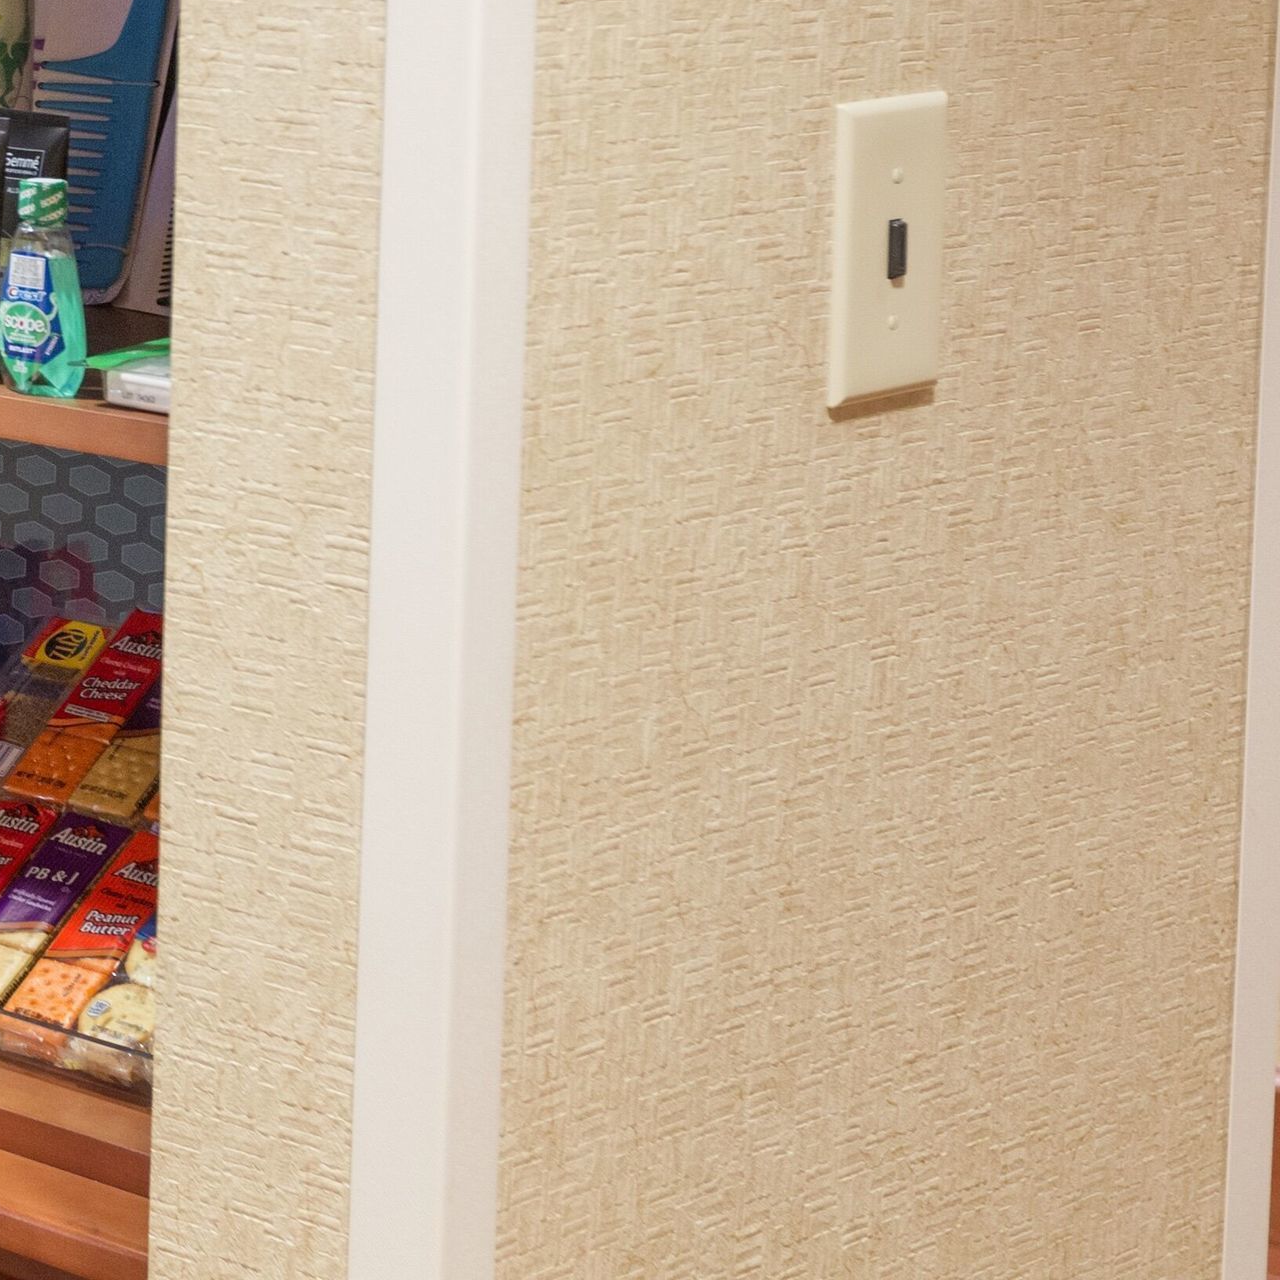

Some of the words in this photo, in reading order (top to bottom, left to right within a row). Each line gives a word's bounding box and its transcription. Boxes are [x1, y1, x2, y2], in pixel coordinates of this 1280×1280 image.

[5, 151, 40, 170] Semmé
[3, 314, 47, 332] scope
[110, 635, 162, 660] Austin
[81, 676, 141, 691] Cheddar
[79, 687, 128, 701] Cheese
[50, 827, 108, 856] Austin
[25, 866, 48, 880] PB
[52, 869, 68, 883] &
[68, 872, 79, 886] J
[115, 861, 158, 886] Aust
[85, 909, 139, 926] Peanut
[80, 921, 131, 937] Butter
